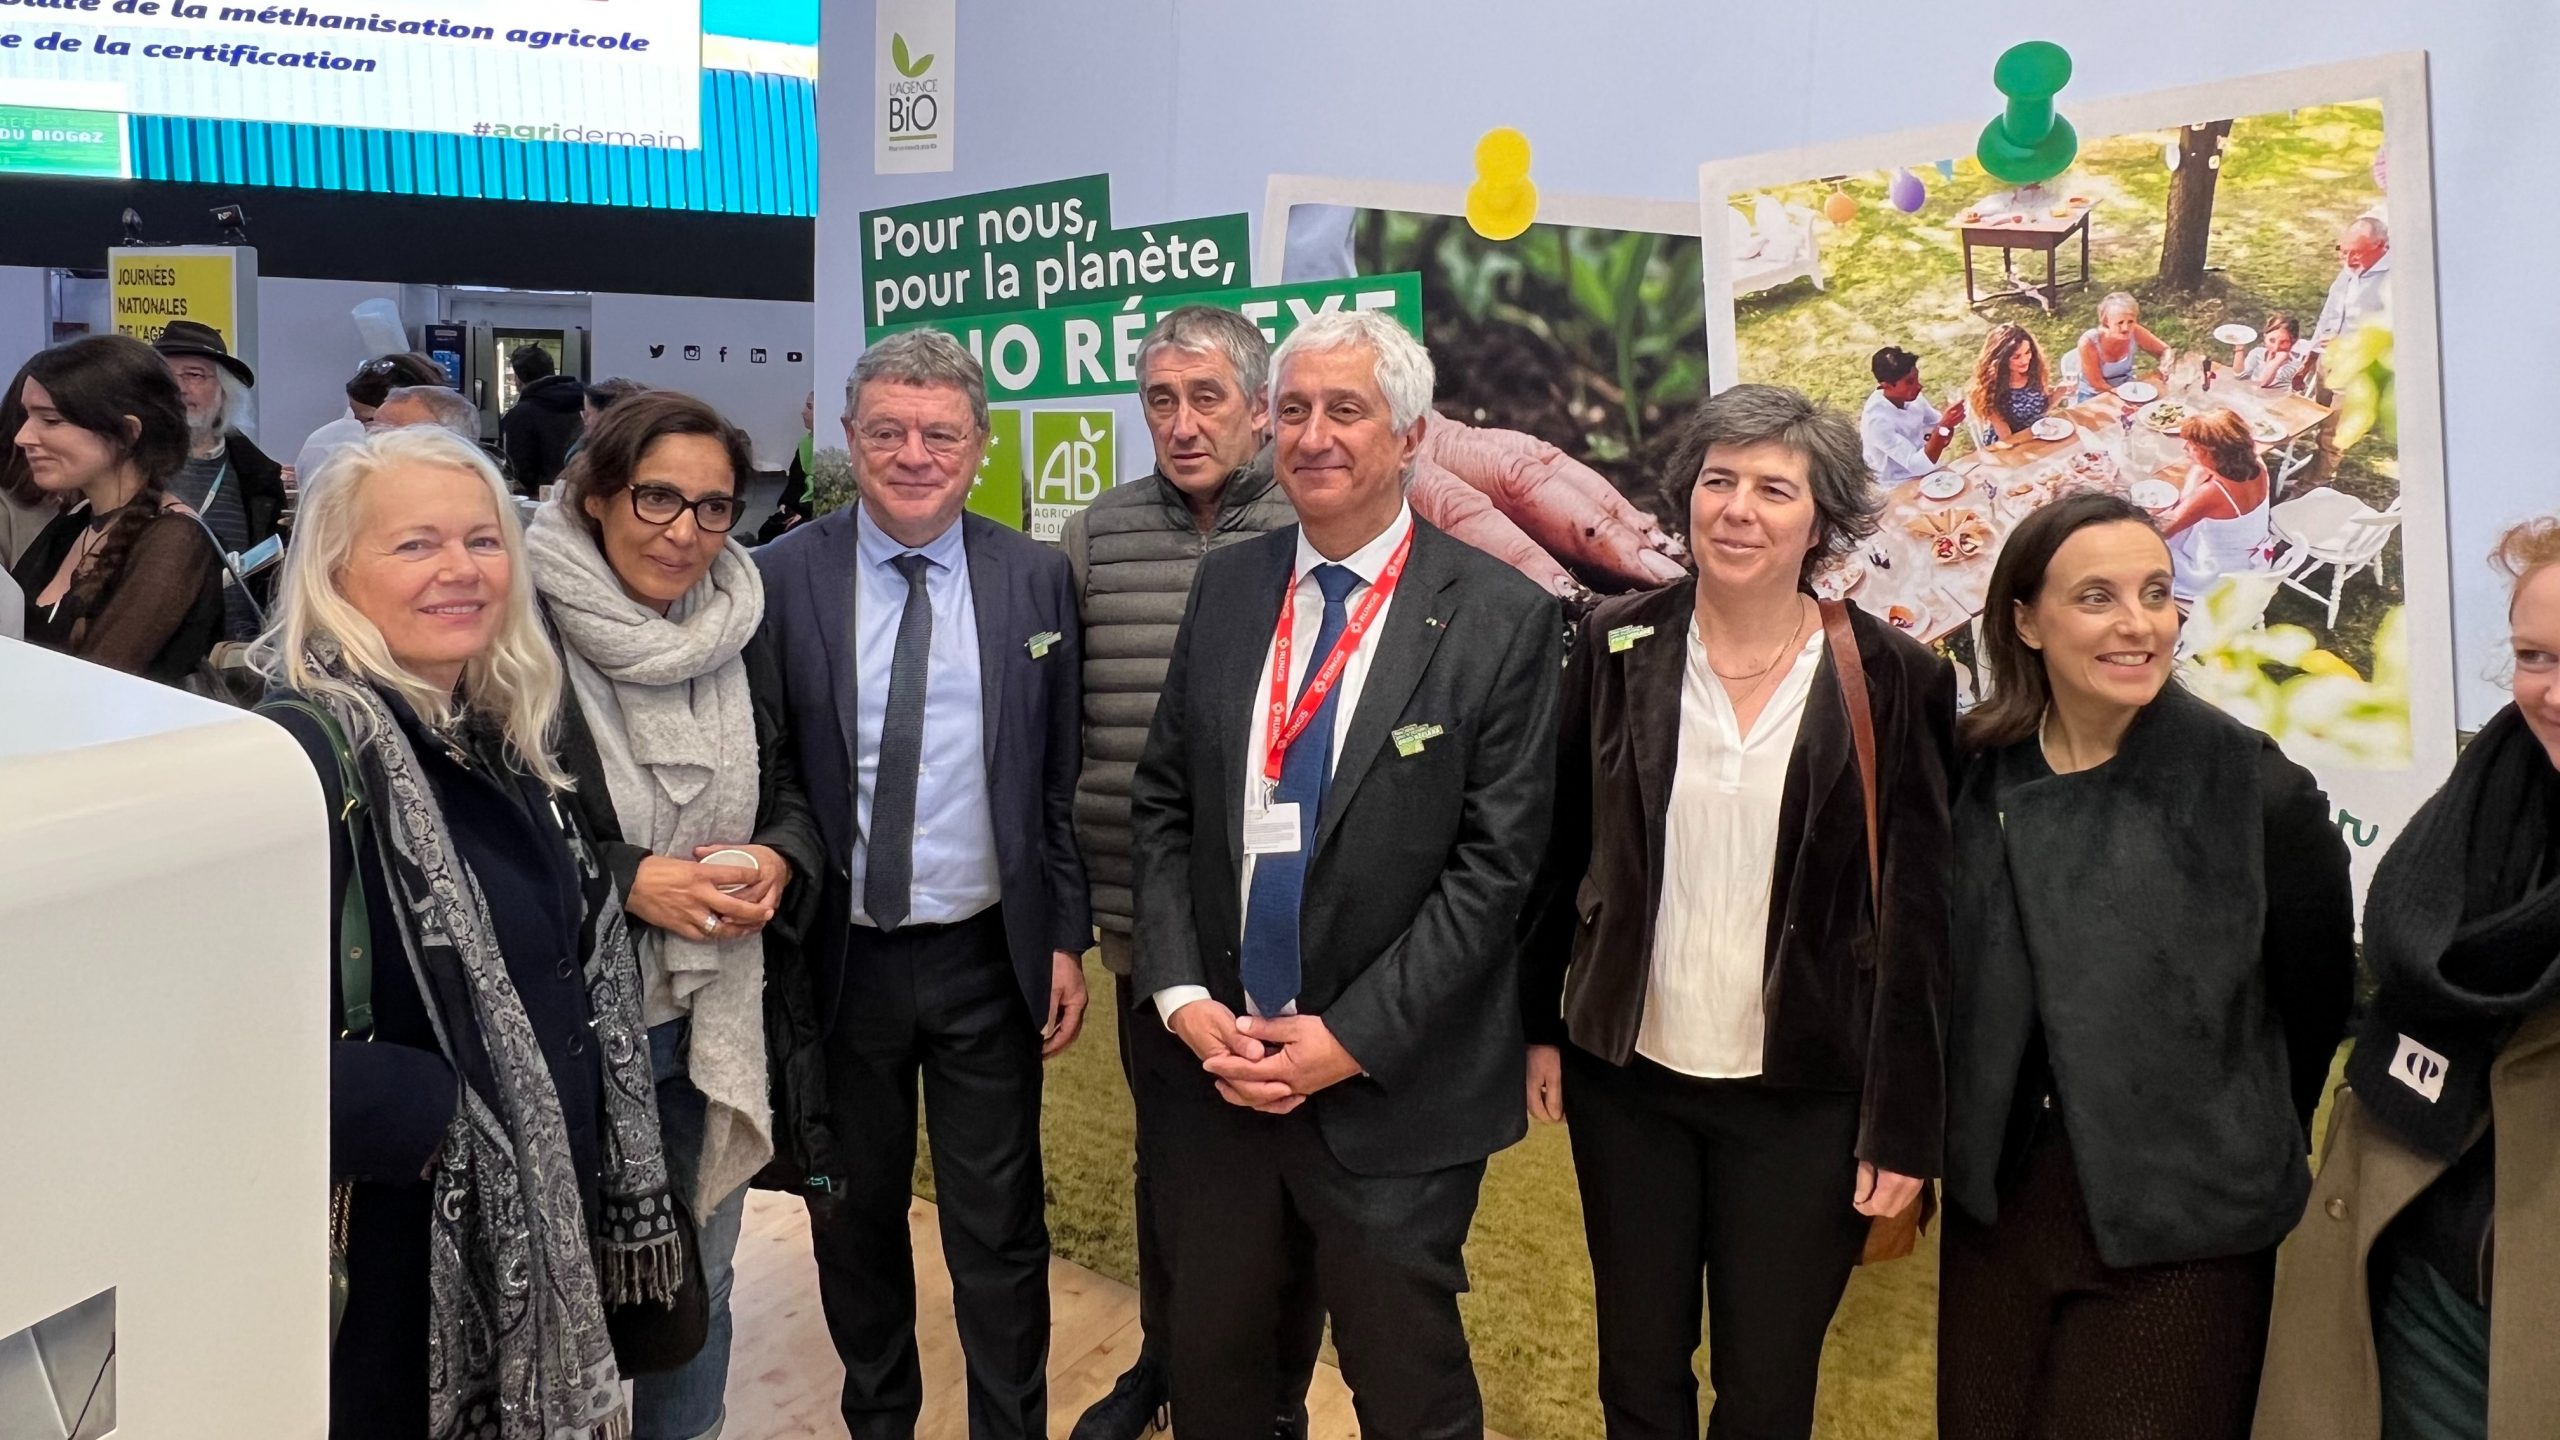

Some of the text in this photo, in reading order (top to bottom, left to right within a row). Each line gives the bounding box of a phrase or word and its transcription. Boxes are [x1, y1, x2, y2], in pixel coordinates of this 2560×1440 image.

[113, 0, 160, 15] de
[170, 0, 215, 19] la
[219, 5, 494, 40] méthanisation
[505, 28, 650, 51] agricole
[0, 31, 376, 73] e de la certification
[889, 79, 938, 97] L'AGENCE
[31, 129, 104, 144] BIOGAZ
[473, 121, 686, 151] #agridemain
[873, 197, 1097, 260] Pour nous,
[118, 264, 176, 286] JOURNÉES
[875, 231, 1236, 326] pour la planète,
[118, 297, 188, 316] NATIONALES
[1039, 440, 1101, 501] AB
